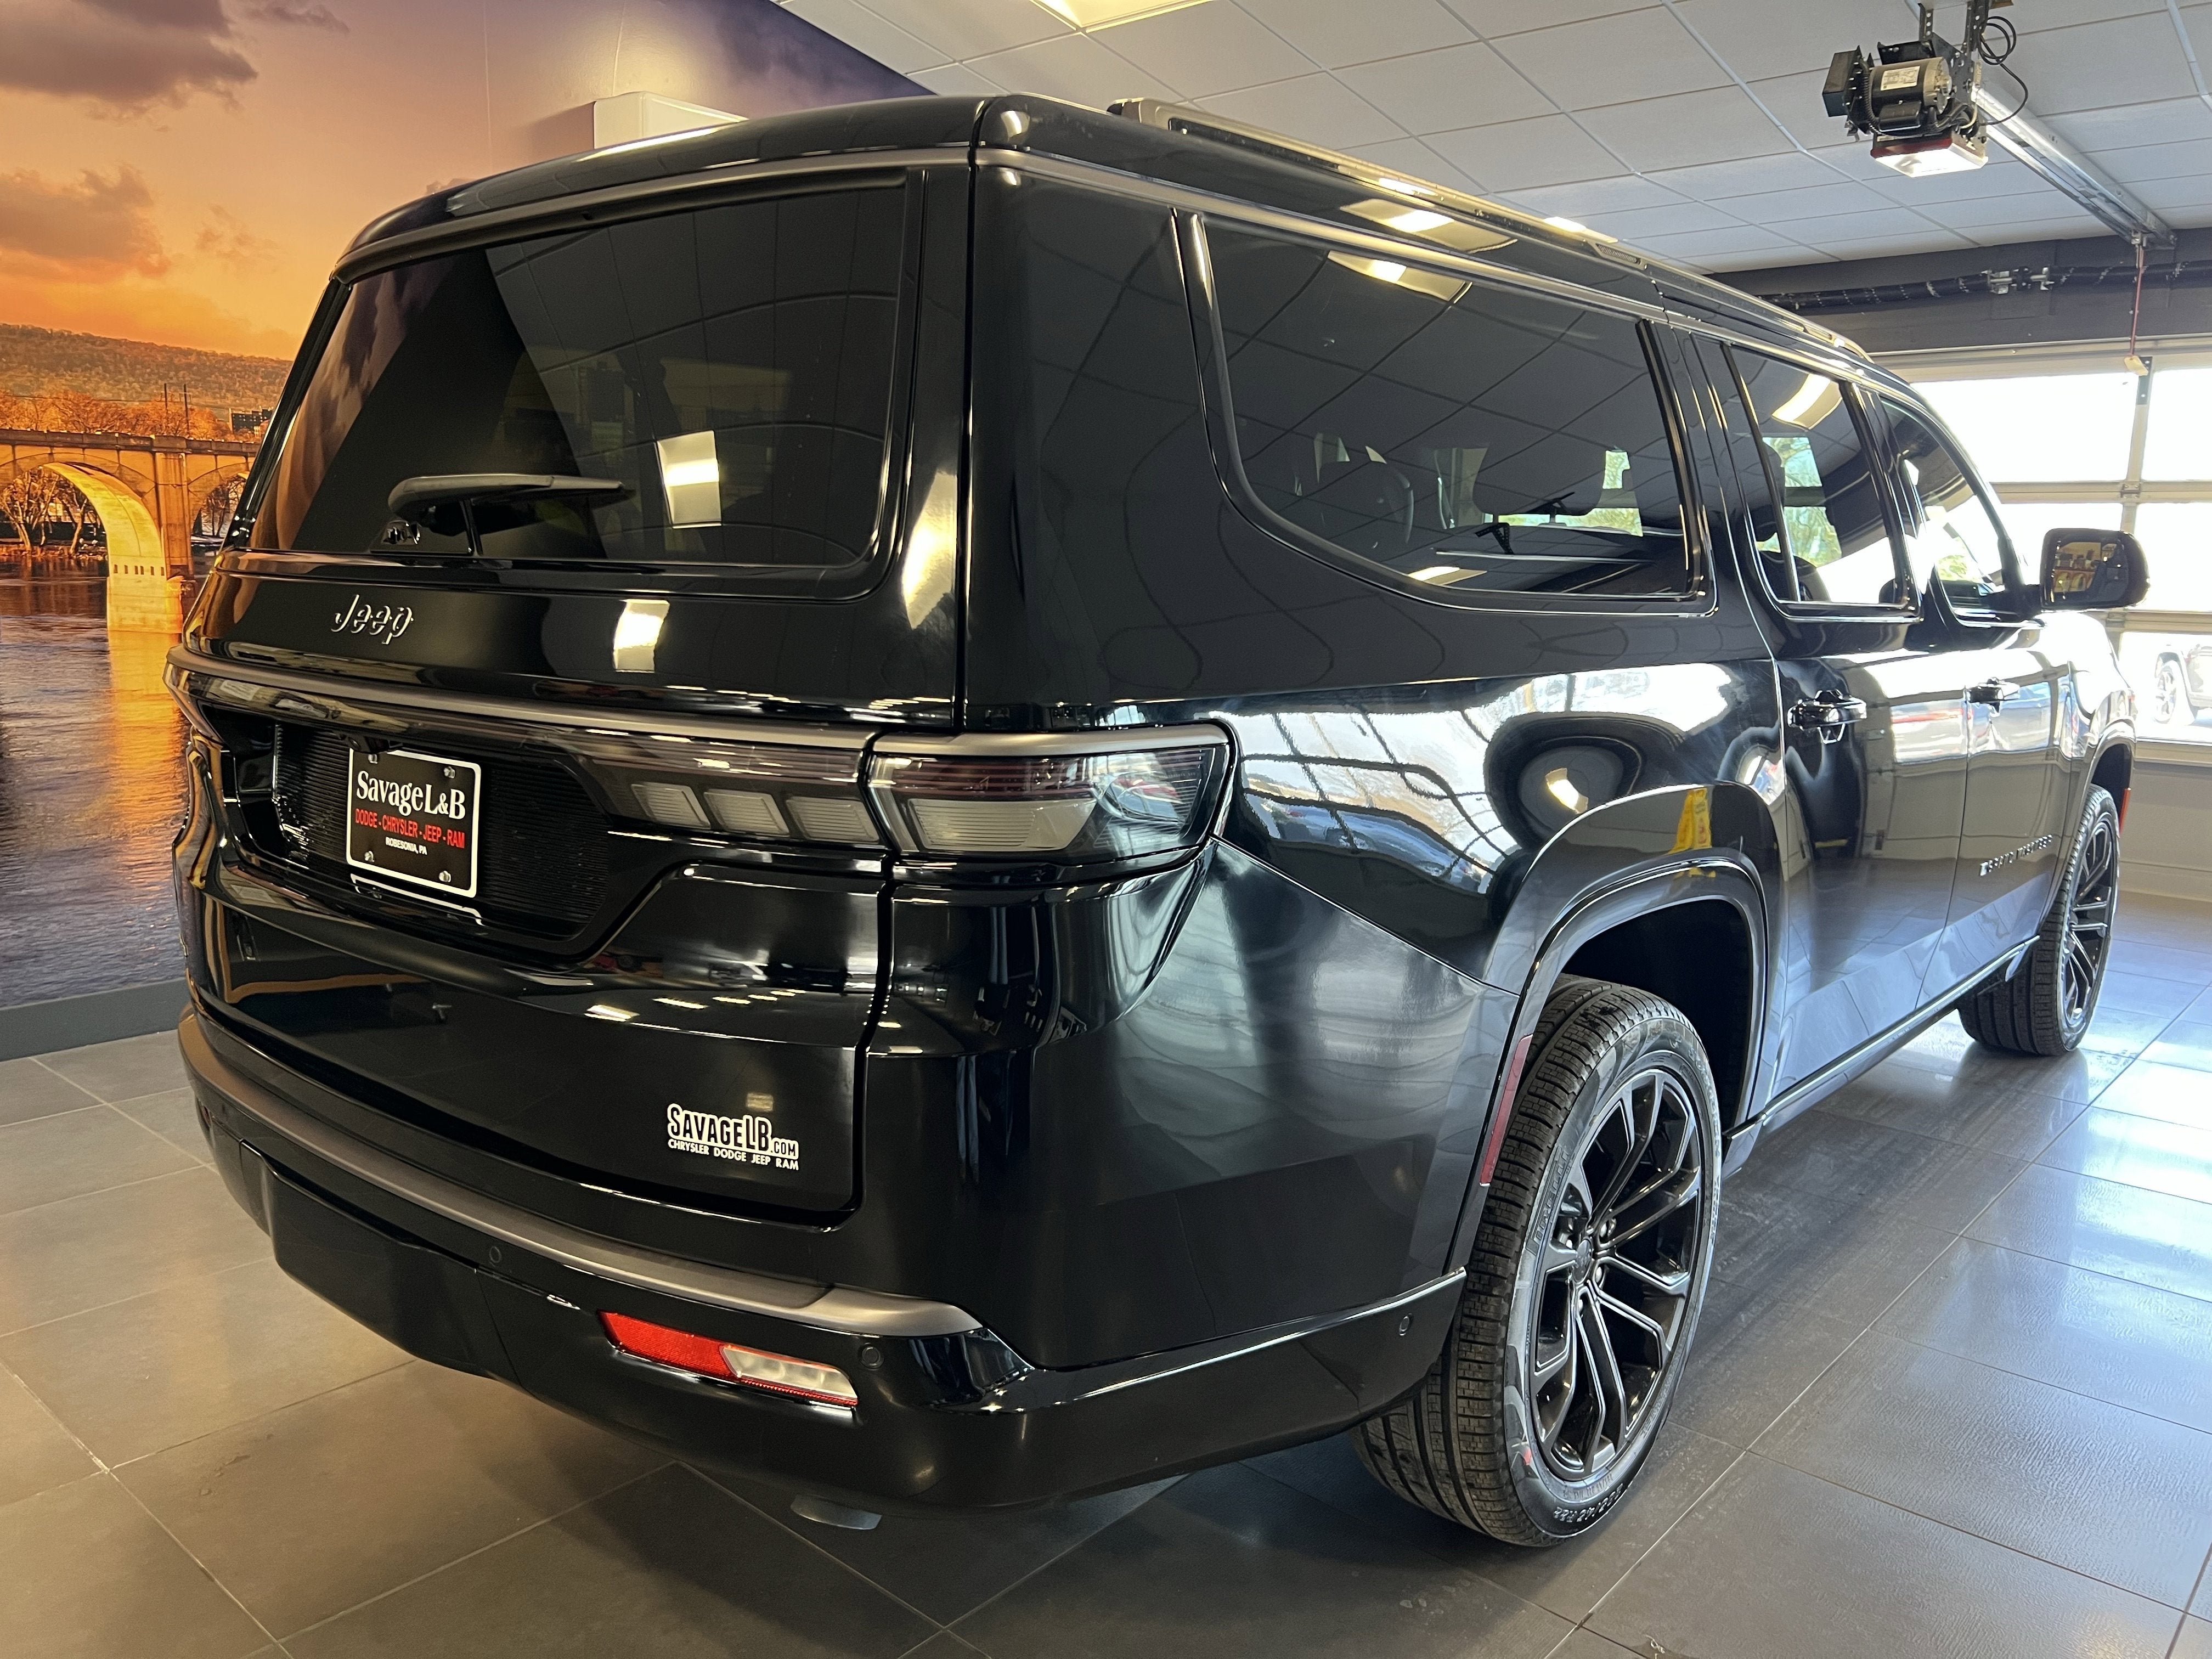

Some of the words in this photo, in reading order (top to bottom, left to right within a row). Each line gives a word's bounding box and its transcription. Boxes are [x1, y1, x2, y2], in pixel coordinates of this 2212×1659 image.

[331, 594, 414, 645] Jeep
[355, 808, 377, 828] DODGE
[382, 815, 418, 838] CHRYSLER
[423, 825, 442, 843] JEEP
[447, 830, 465, 848] RAM
[419, 845, 427, 855] PA
[668, 1138, 709, 1155] CHRYSLER
[714, 1147, 747, 1162] DODGE
[751, 1154, 771, 1166] JEEP
[775, 1158, 799, 1171] RAM
